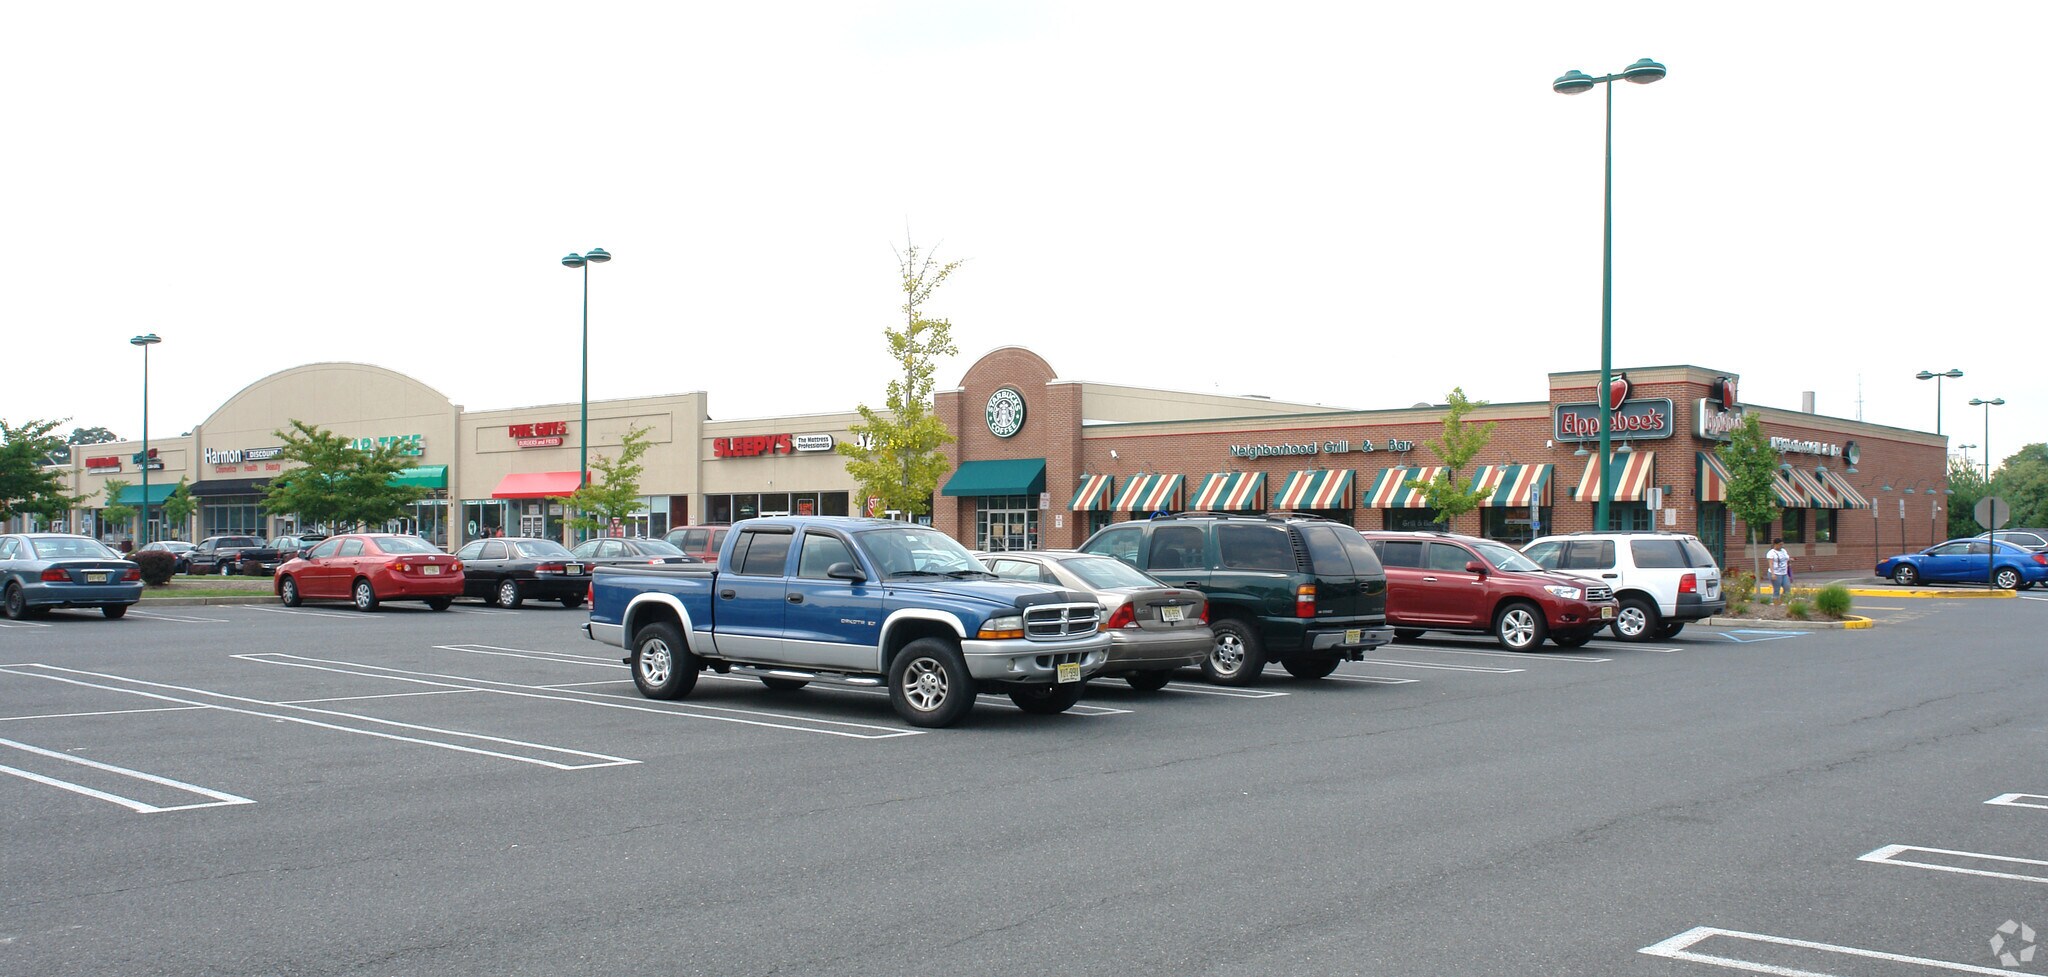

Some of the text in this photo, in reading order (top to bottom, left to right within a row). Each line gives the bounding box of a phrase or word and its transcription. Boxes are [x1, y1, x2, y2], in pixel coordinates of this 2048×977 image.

[988, 391, 1021, 412] STARBUCKS
[508, 421, 567, 437] FIVE GUYS
[991, 422, 1017, 434] COFFEE
[249, 449, 279, 458] DISCOUNT
[713, 433, 791, 457] SLEEPY'S
[1230, 439, 1412, 460] Neighborhood Grill & Bar
[204, 447, 242, 464] Harmon
